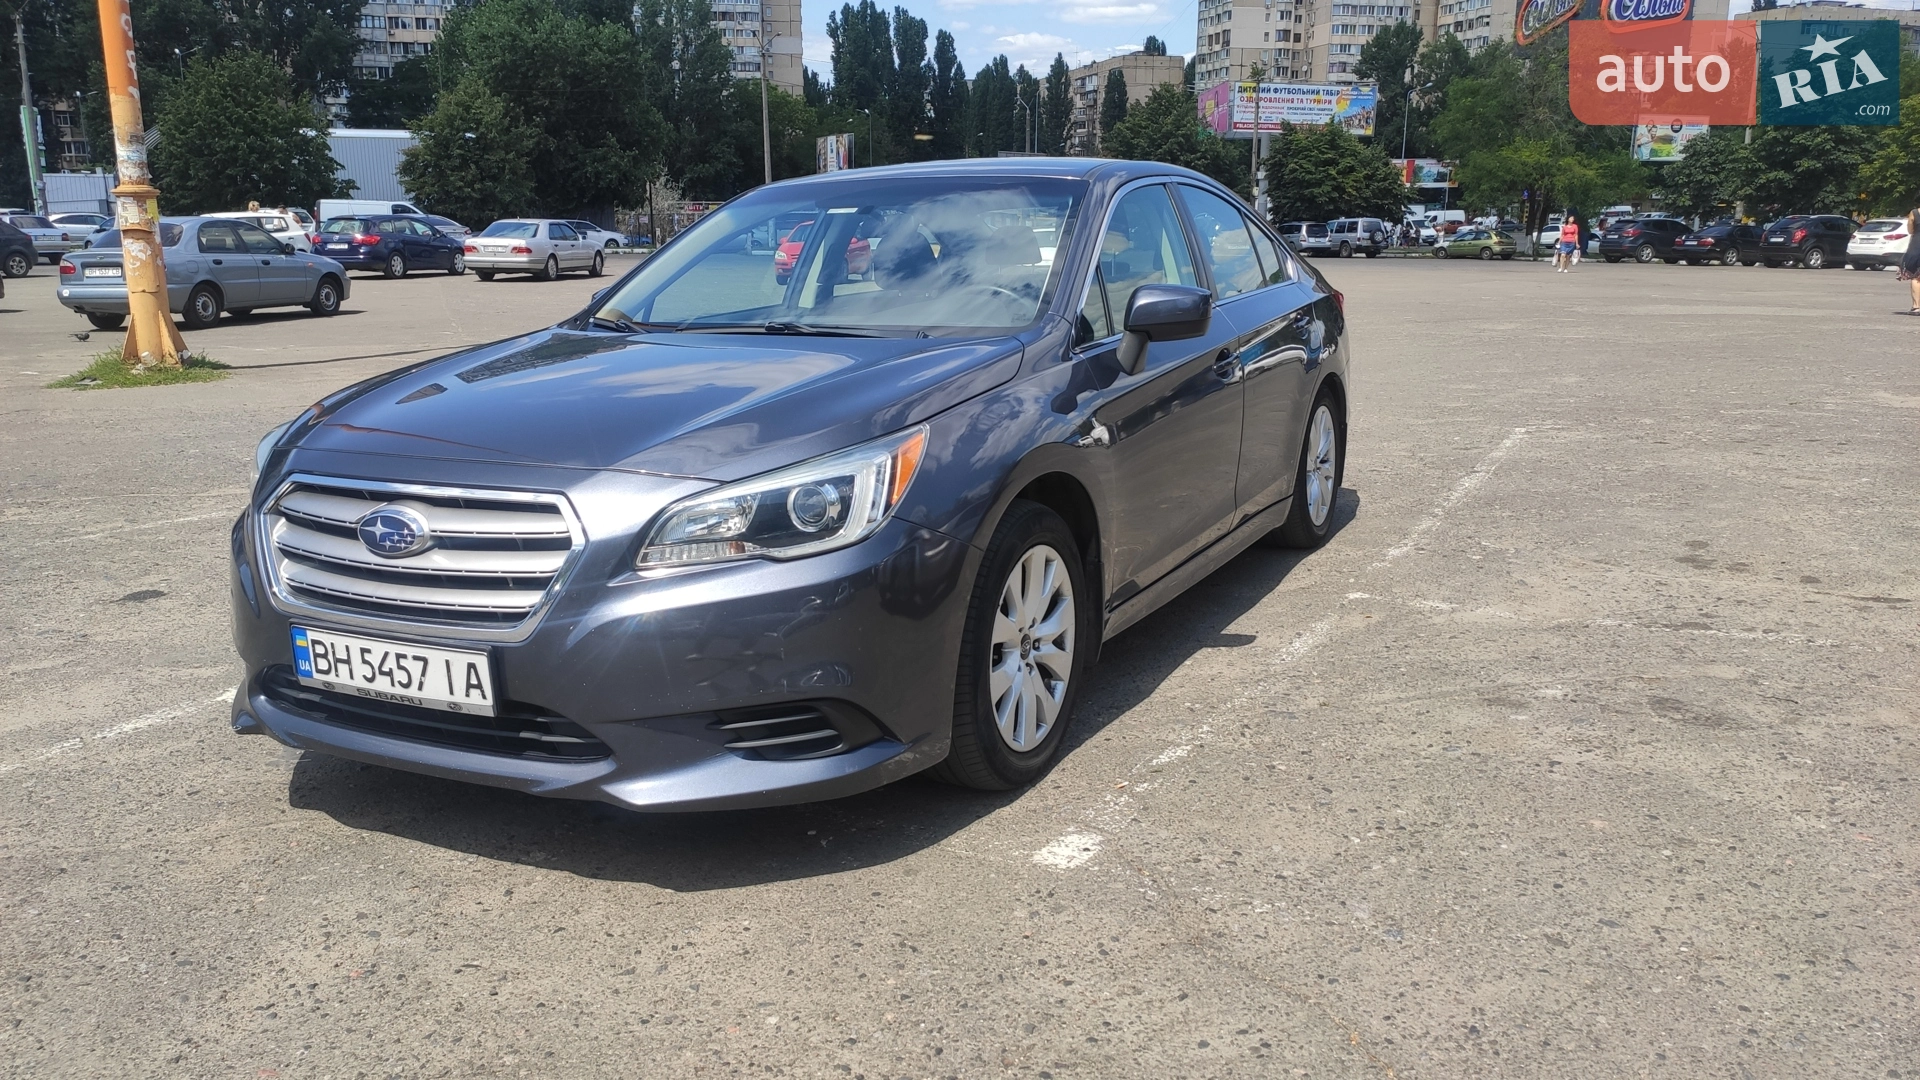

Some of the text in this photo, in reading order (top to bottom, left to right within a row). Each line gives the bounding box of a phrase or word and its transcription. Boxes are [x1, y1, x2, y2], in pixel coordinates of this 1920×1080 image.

[1273, 86, 1320, 96] ФУТБОЛЬНИЙ
[299, 659, 312, 671] UA
[310, 638, 488, 701] BH 5457 IA
[356, 688, 423, 706] SUBARU
